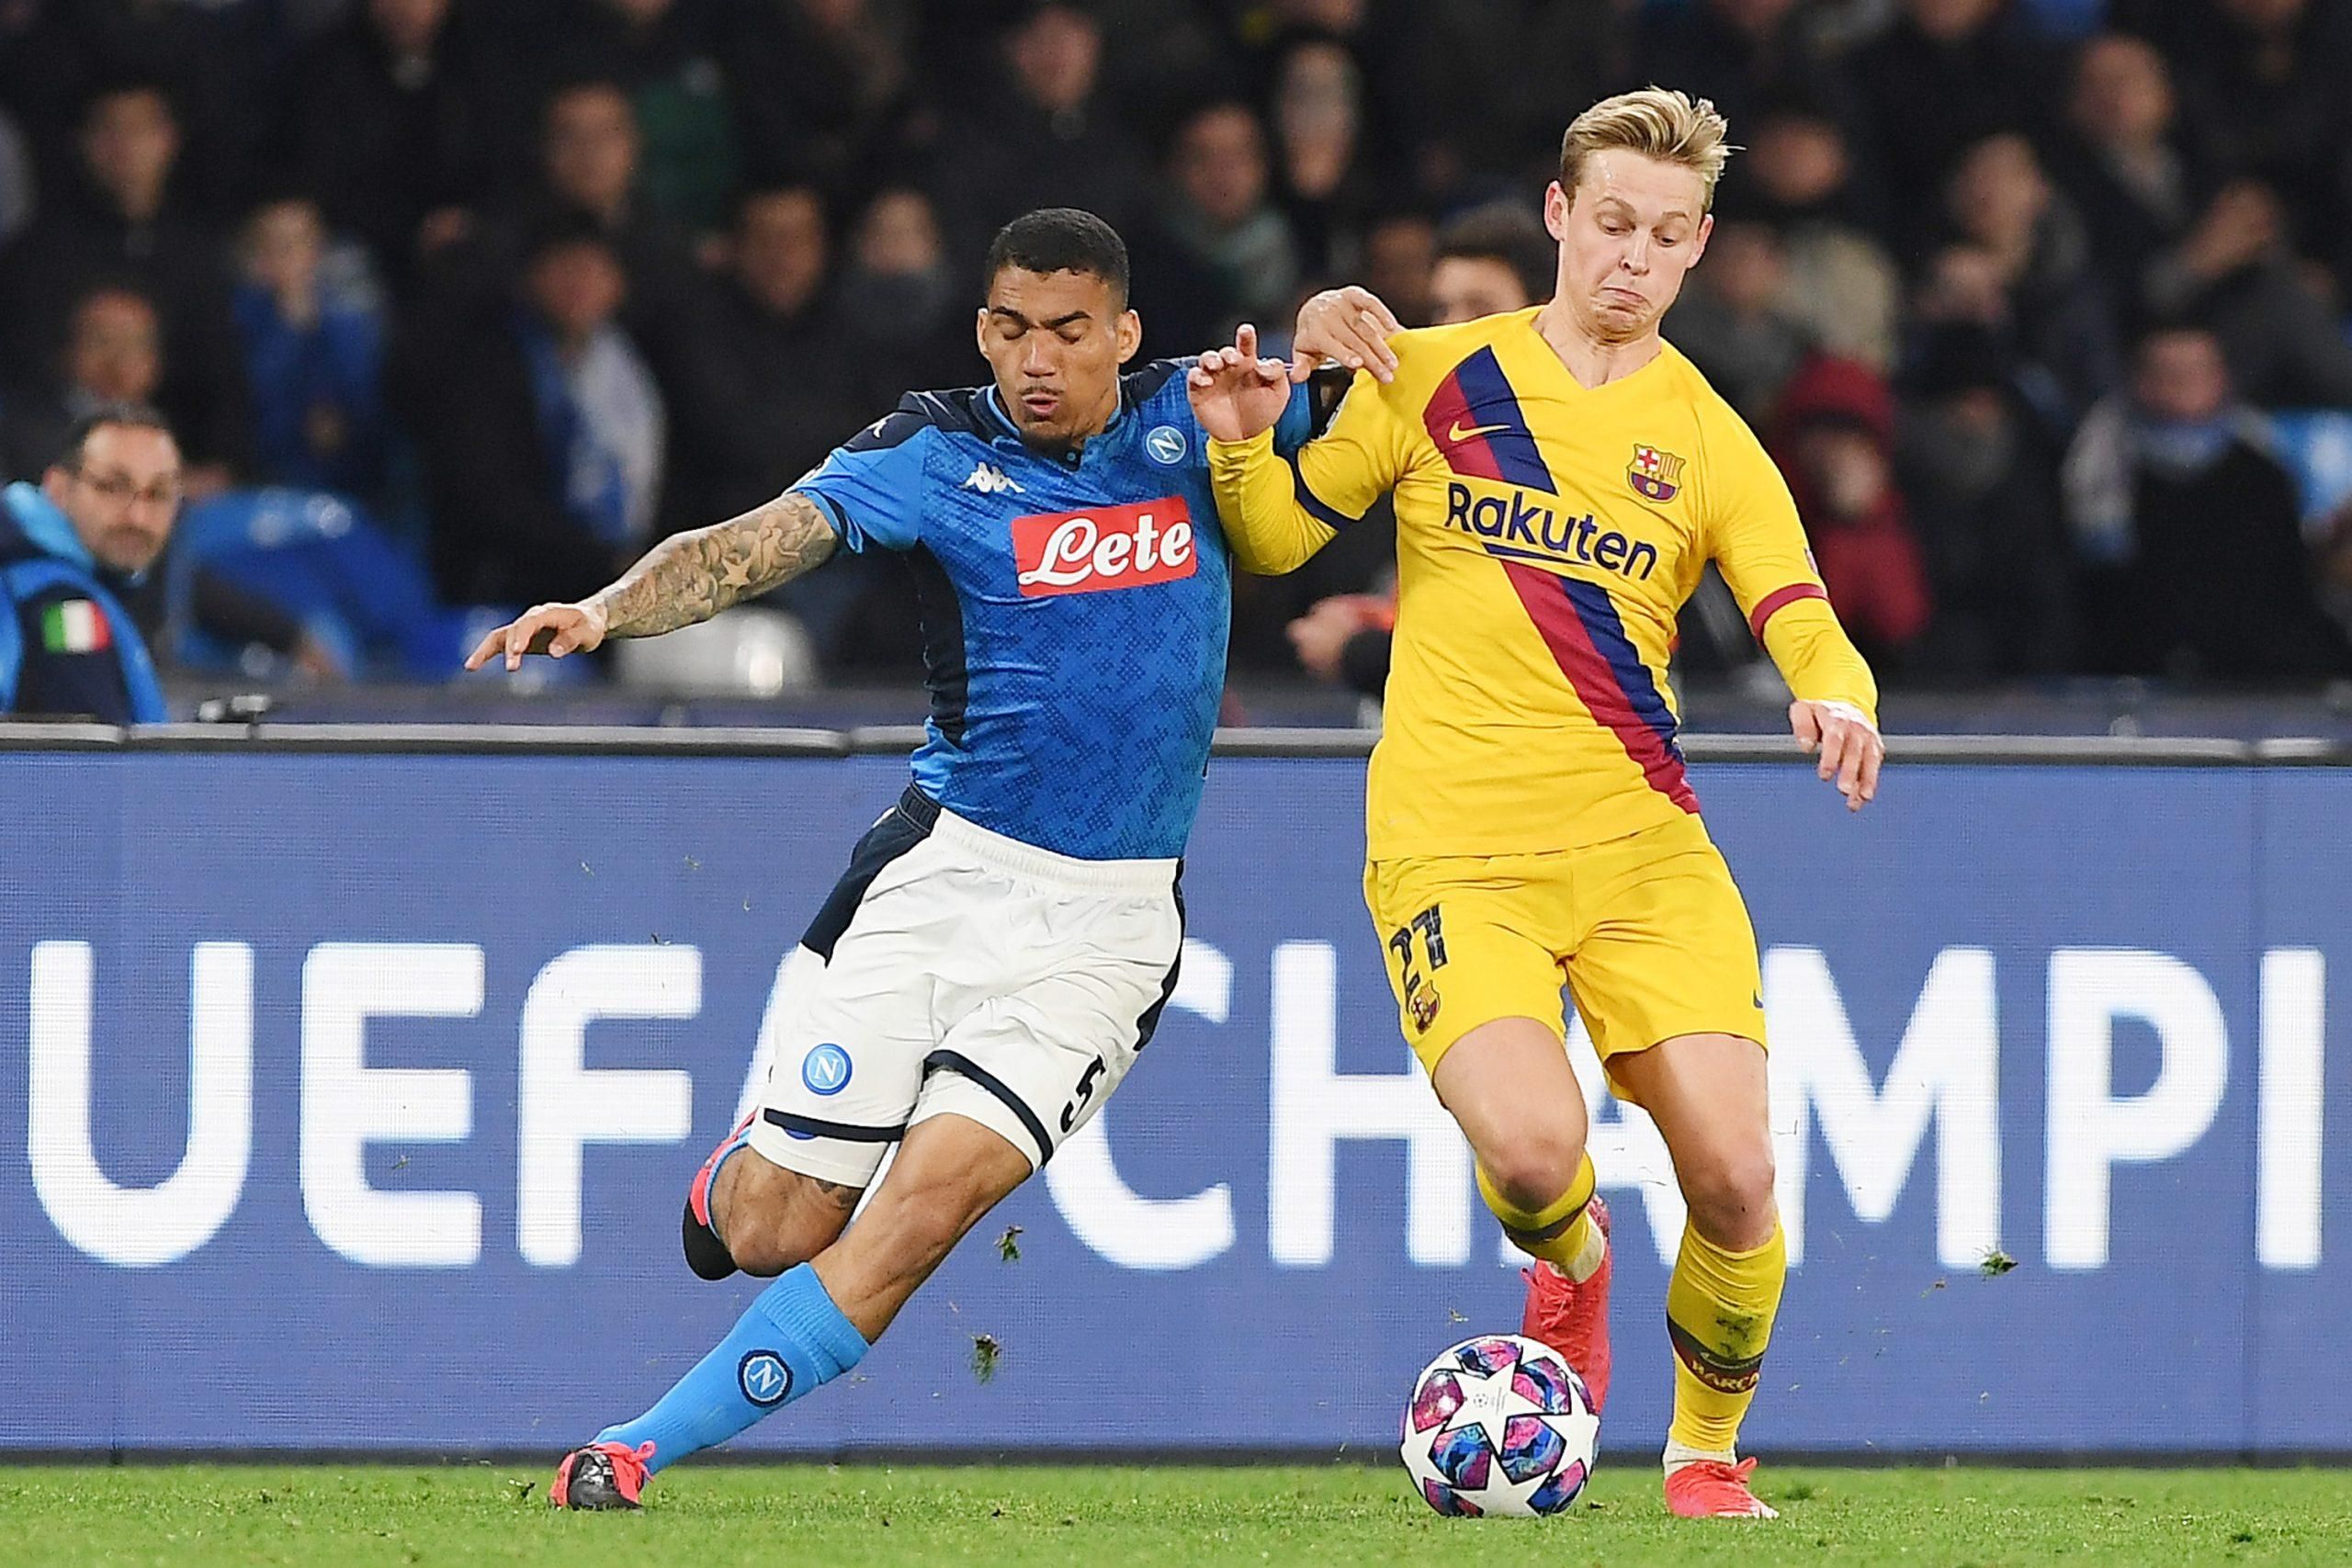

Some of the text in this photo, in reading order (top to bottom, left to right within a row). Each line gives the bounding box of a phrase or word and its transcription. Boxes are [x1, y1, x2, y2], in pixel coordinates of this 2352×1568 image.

[1151, 431, 1180, 459] N
[1018, 513, 1193, 586] Lete
[1444, 481, 1657, 581] Rakuten
[28, 941, 796, 1267] UEF
[814, 1055, 838, 1082] N
[1060, 1055, 1106, 1134] 5
[751, 1361, 781, 1393] N
